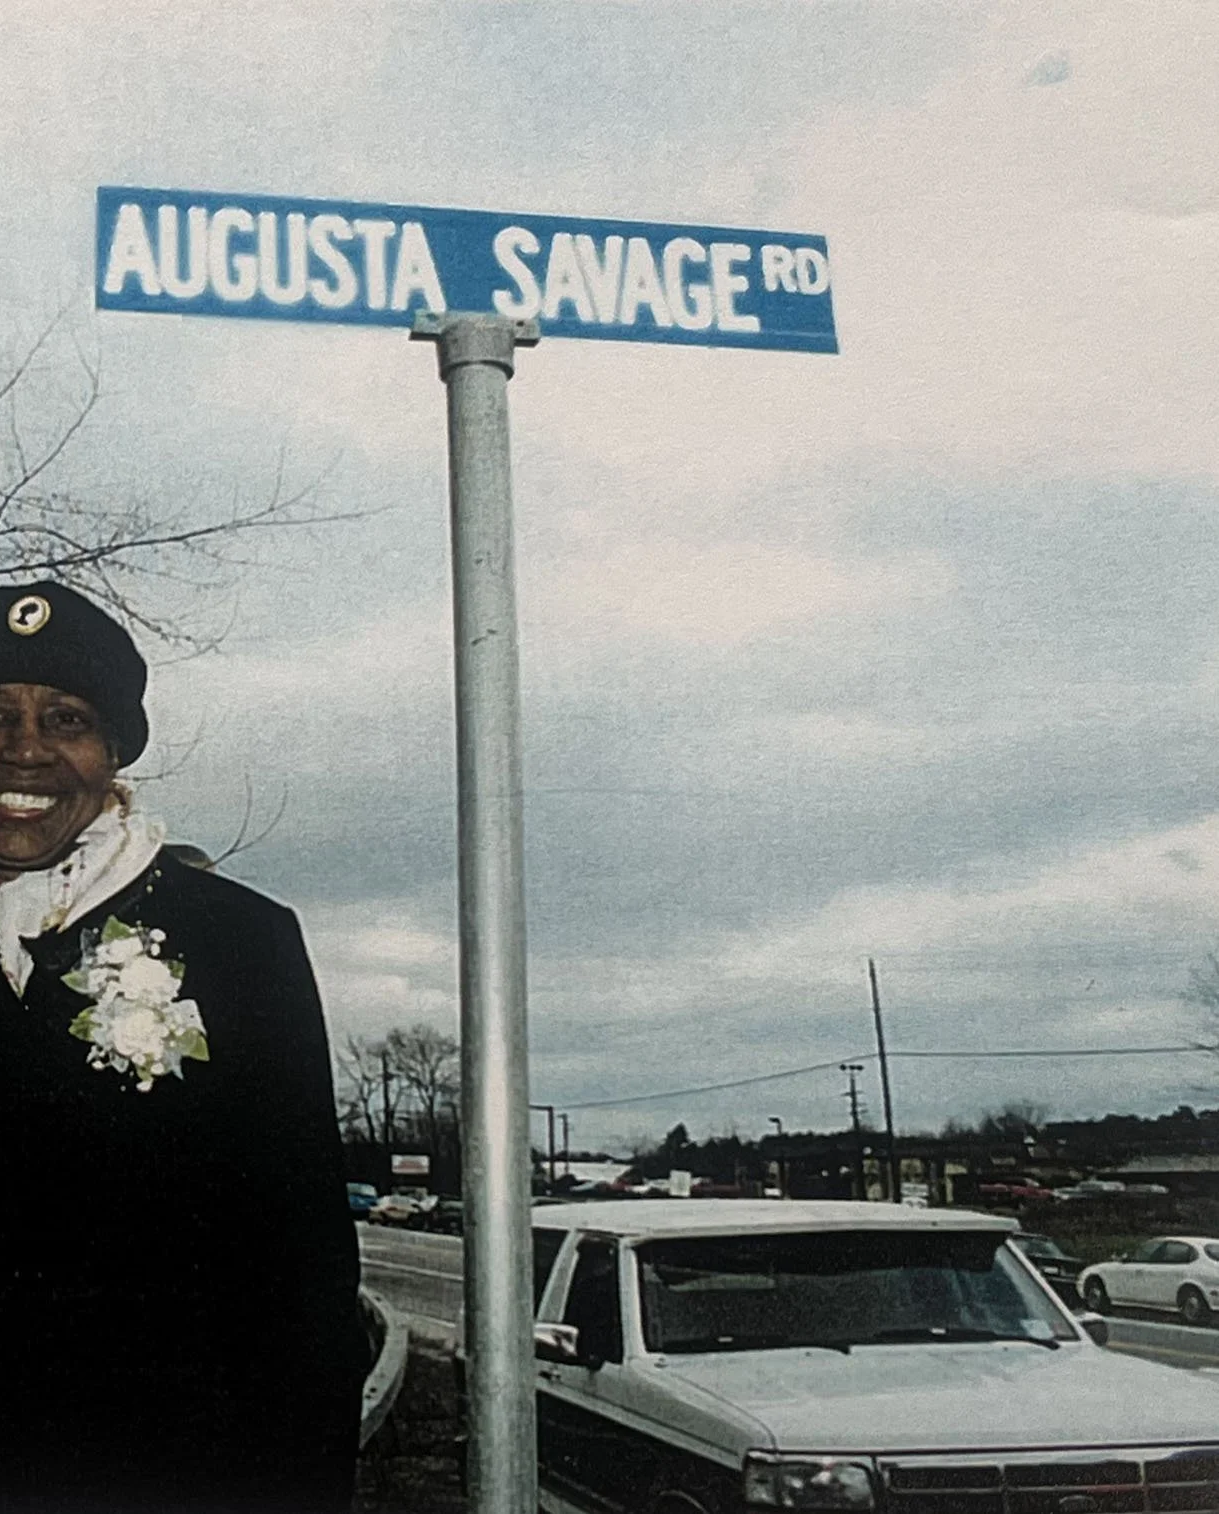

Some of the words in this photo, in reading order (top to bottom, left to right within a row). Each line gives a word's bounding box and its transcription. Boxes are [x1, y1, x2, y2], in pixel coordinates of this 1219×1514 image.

[104, 202, 447, 313] AUGUSTA
[493, 226, 761, 333] SAVAGE
[760, 243, 830, 296] RD
